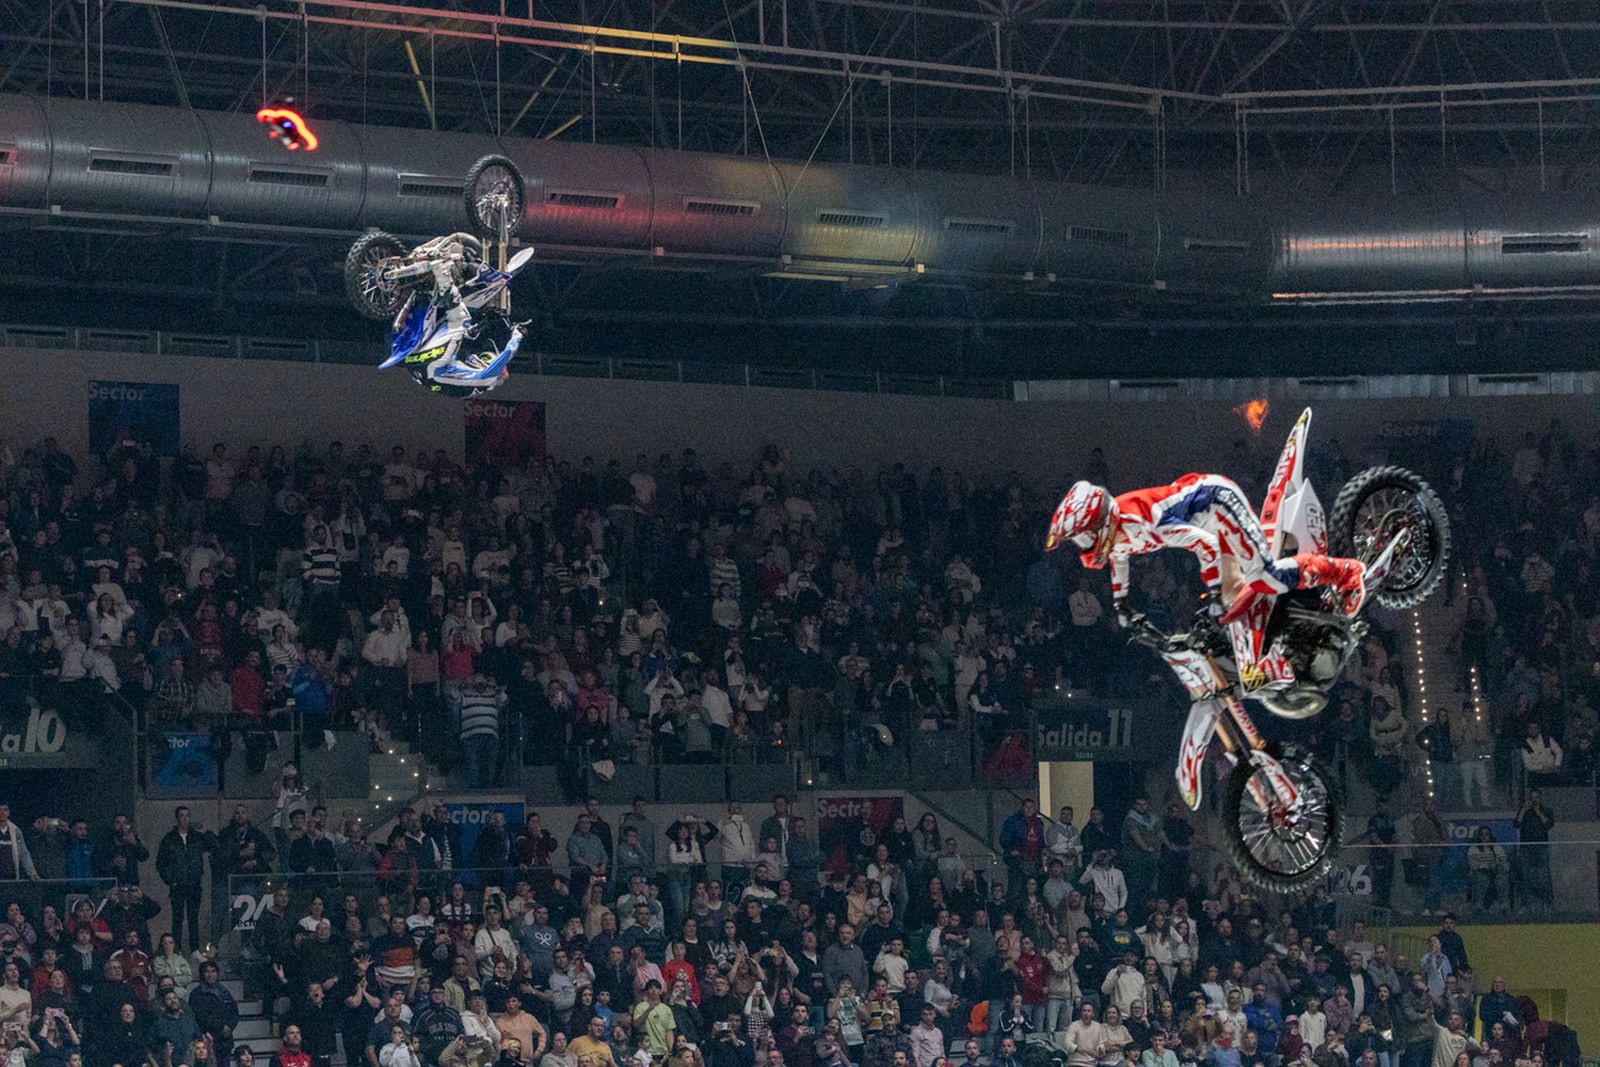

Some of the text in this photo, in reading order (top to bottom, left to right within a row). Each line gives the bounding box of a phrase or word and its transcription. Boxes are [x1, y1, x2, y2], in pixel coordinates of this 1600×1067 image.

[89, 381, 147, 400] Sector
[464, 400, 516, 418] Sector
[24, 708, 67, 753] 10
[1037, 708, 1133, 747] Salida 11
[449, 806, 490, 825] ctor
[1447, 822, 1479, 839] tor
